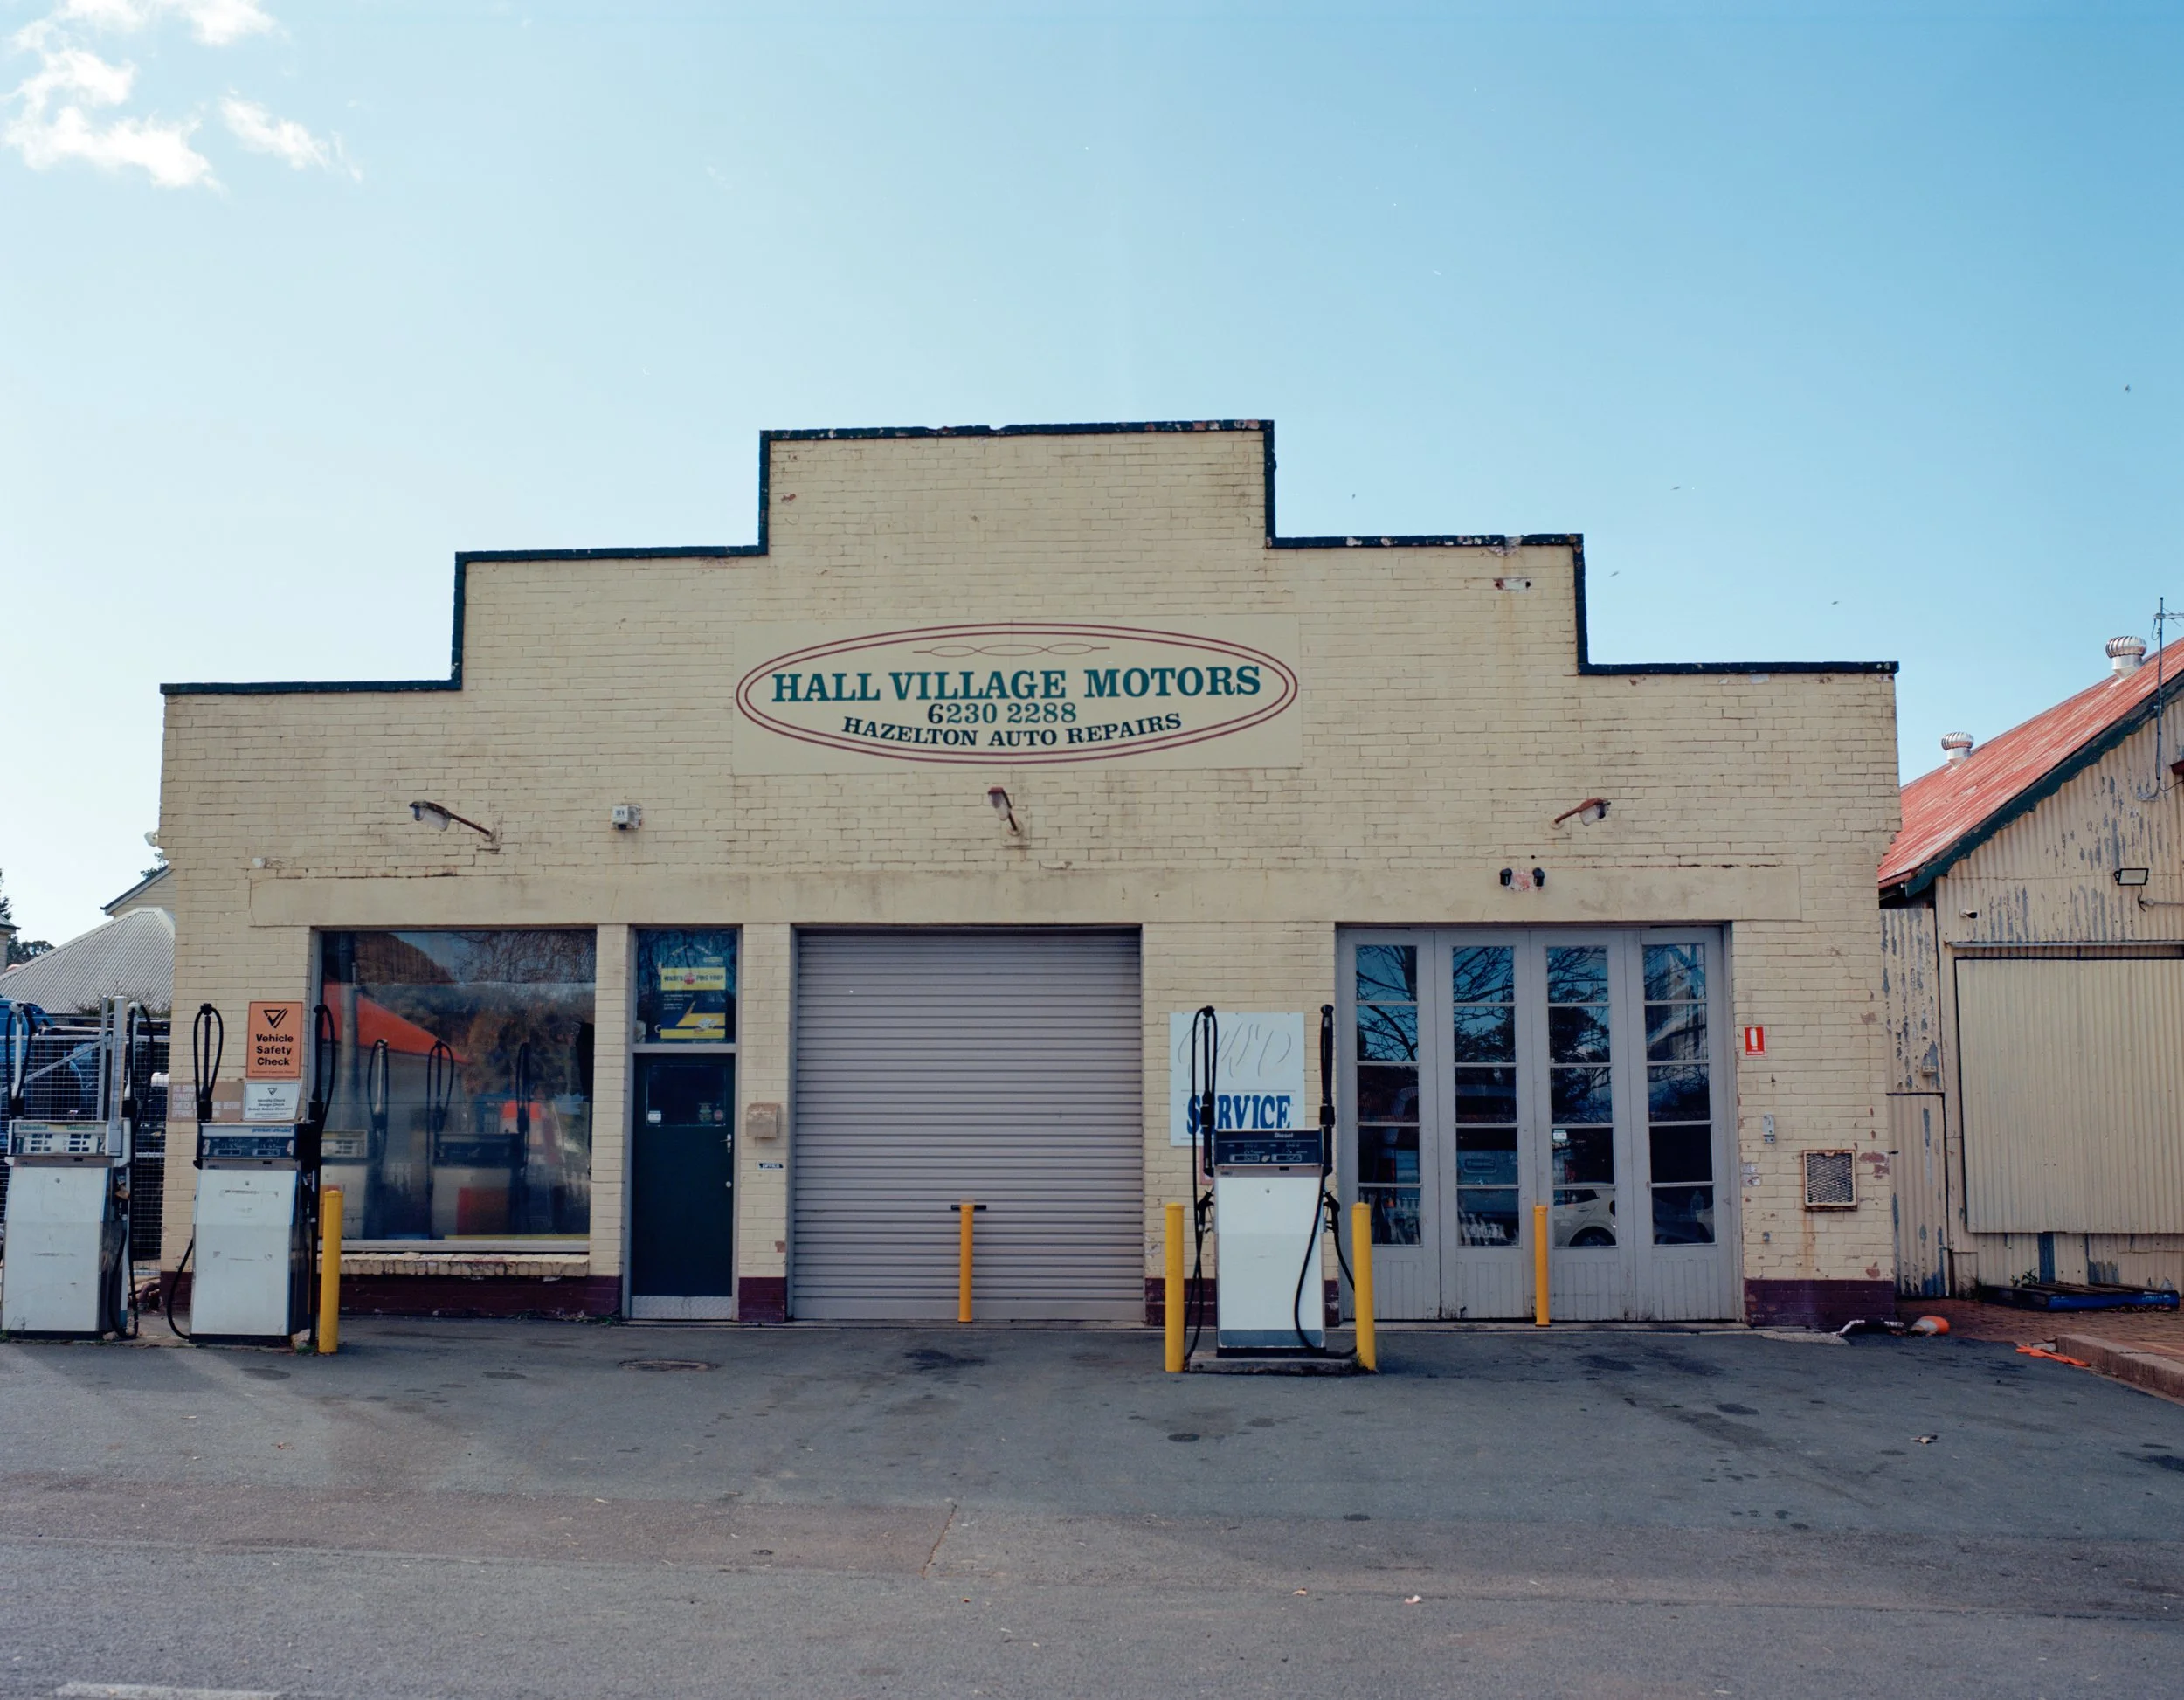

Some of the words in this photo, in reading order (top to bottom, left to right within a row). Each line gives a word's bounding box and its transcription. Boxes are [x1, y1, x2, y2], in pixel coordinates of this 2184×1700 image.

[771, 673, 881, 702] HALL
[888, 670, 1067, 701] VILLAGE
[1083, 666, 1261, 697] MOTORS
[927, 702, 998, 724] 6230
[1007, 702, 1076, 724] 2288
[841, 716, 978, 746] HAZELTON
[988, 729, 1057, 747] AUTO
[1066, 713, 1182, 744] REPAIRS
[255, 1033, 294, 1043] Vehicle
[256, 1045, 292, 1055] Safety
[257, 1057, 290, 1066] Check
[1187, 1095, 1291, 1136] SRVICE
